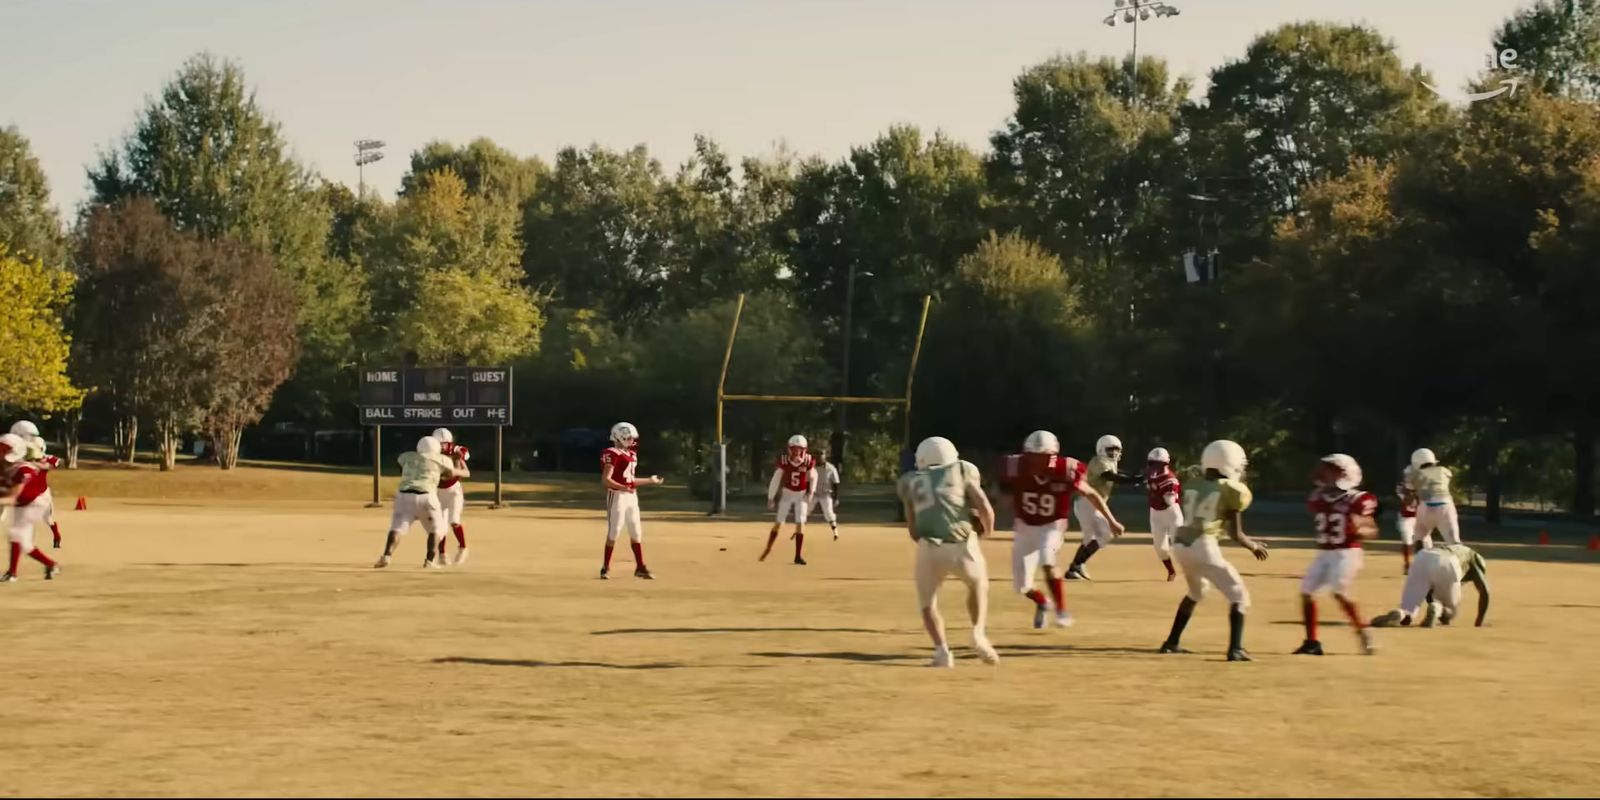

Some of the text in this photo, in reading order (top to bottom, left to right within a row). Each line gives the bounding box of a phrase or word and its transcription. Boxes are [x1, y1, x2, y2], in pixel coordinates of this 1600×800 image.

[366, 371, 398, 382] HOME
[472, 371, 506, 382] GUEST
[365, 408, 395, 418] BALL
[403, 408, 443, 418] STRIKE
[452, 408, 476, 418] OUT
[790, 471, 801, 487] 5
[1021, 491, 1056, 516] 59
